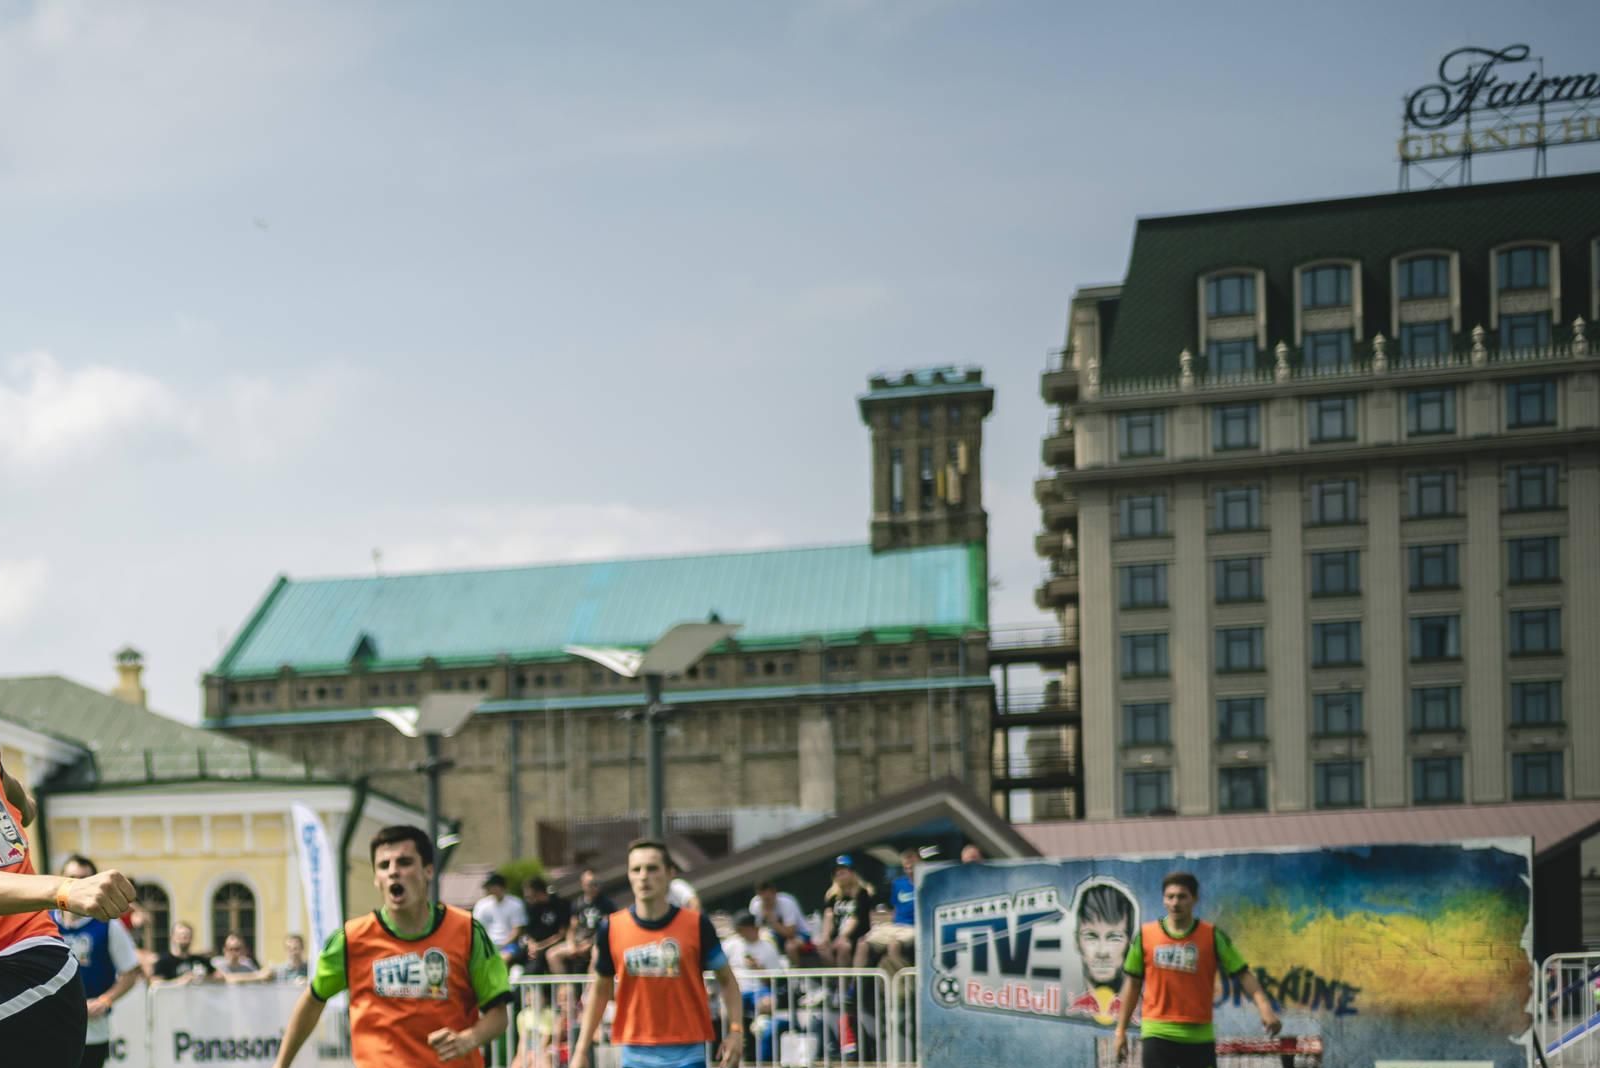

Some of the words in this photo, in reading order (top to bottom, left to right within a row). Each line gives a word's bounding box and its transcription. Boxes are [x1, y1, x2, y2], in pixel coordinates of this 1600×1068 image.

[1397, 121, 1545, 161] GRAND
[941, 909, 1065, 979] FIVE
[375, 960, 421, 984] FIVE
[966, 981, 1011, 1007] Red
[1015, 985, 1061, 1013] Bull
